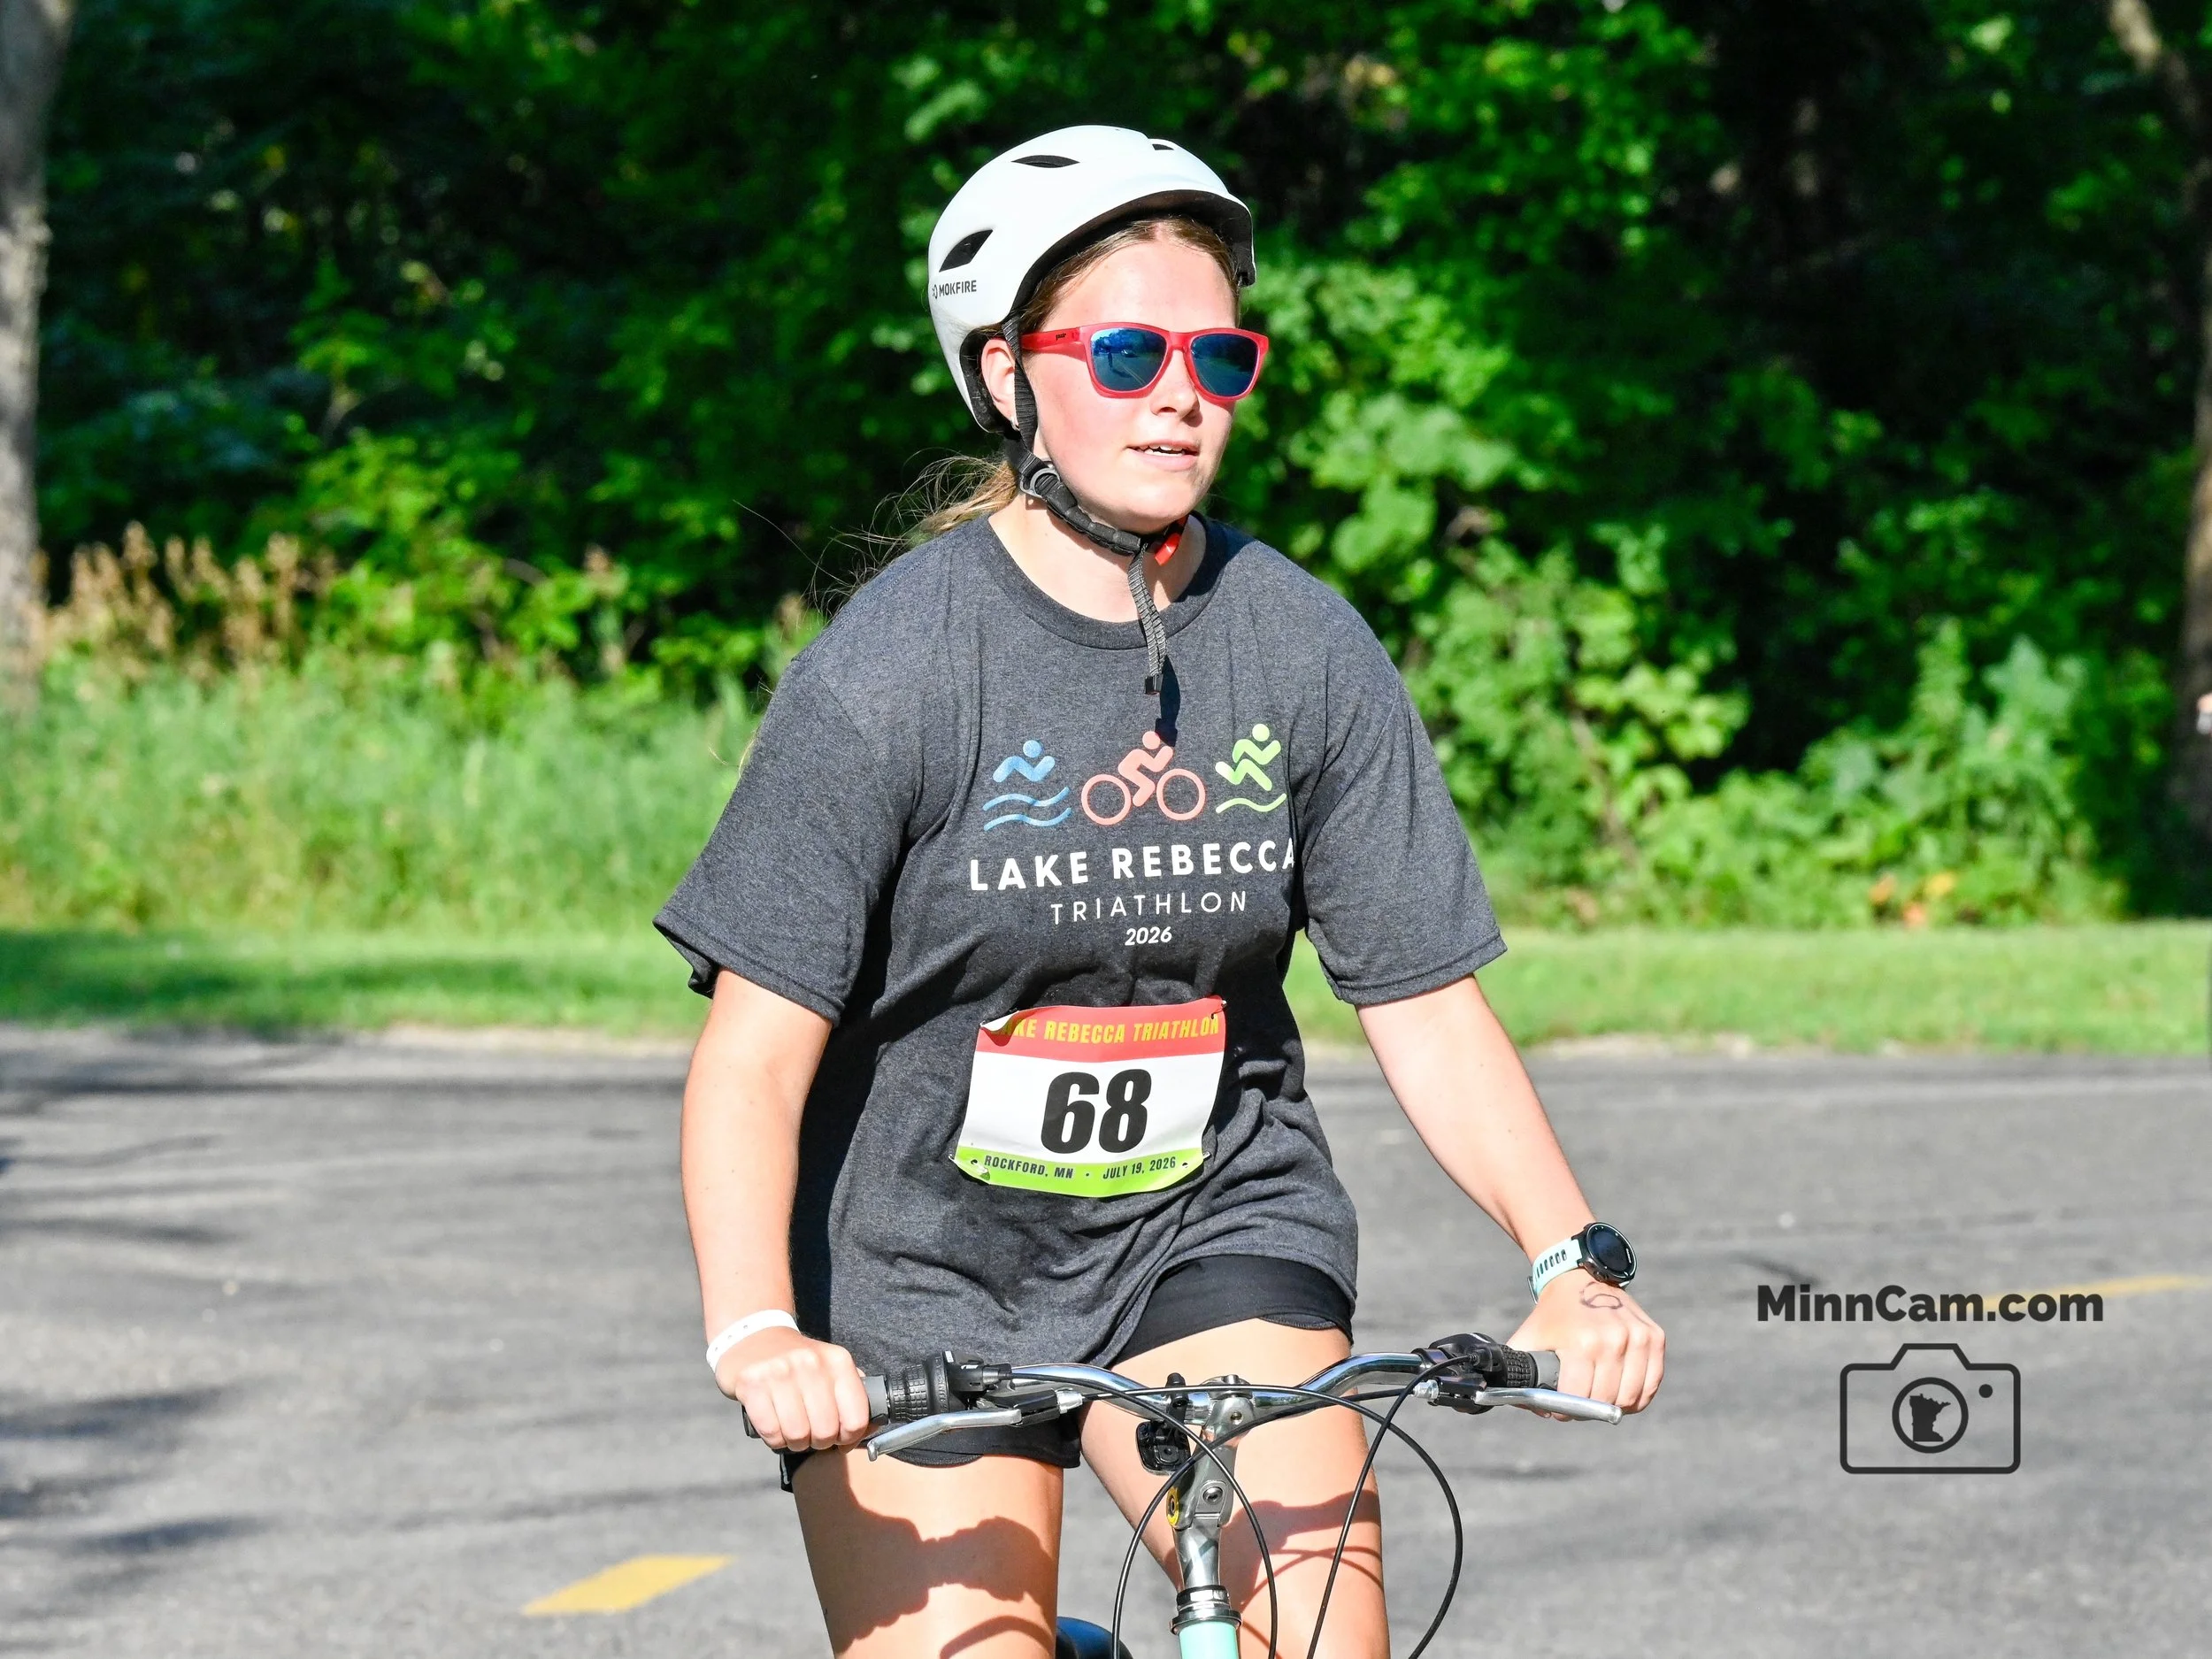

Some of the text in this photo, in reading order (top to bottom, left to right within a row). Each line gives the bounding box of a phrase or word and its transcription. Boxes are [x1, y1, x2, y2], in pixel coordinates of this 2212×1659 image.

[939, 280, 977, 297] MOKFIRE
[970, 837, 1294, 890] LAKE REBECCA
[1050, 891, 1247, 925] TRIATHLON
[1125, 926, 1172, 946] 2026
[1044, 1020, 1125, 1043] REBECCA
[1133, 1014, 1219, 1041] TRIATHLON
[1041, 1068, 1152, 1154] 68
[984, 1155, 1177, 1179] ROCKFORD, MN JULY 19, 2026
